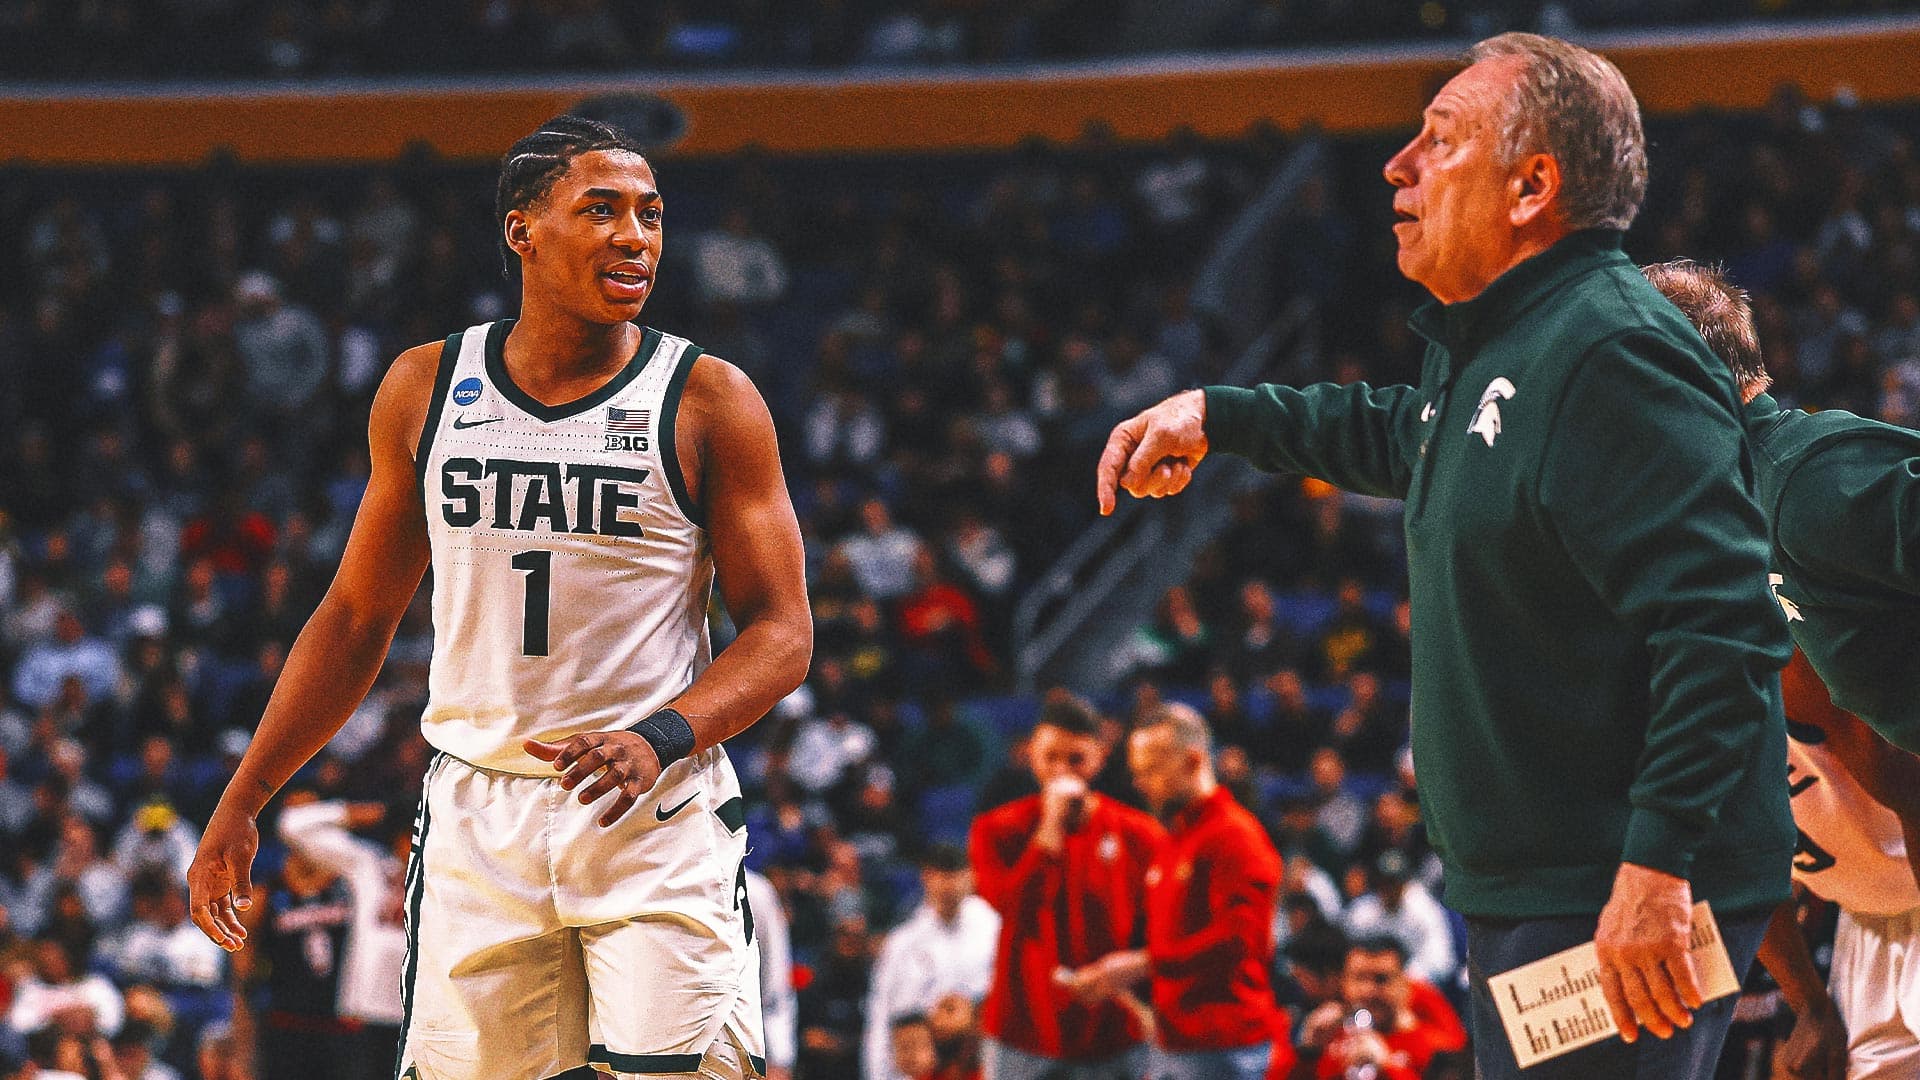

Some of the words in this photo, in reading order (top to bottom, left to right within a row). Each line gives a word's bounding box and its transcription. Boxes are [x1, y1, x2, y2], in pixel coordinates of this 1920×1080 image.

[454, 389, 481, 399] NCAA
[442, 457, 651, 537] STATE
[511, 550, 552, 657] 1
